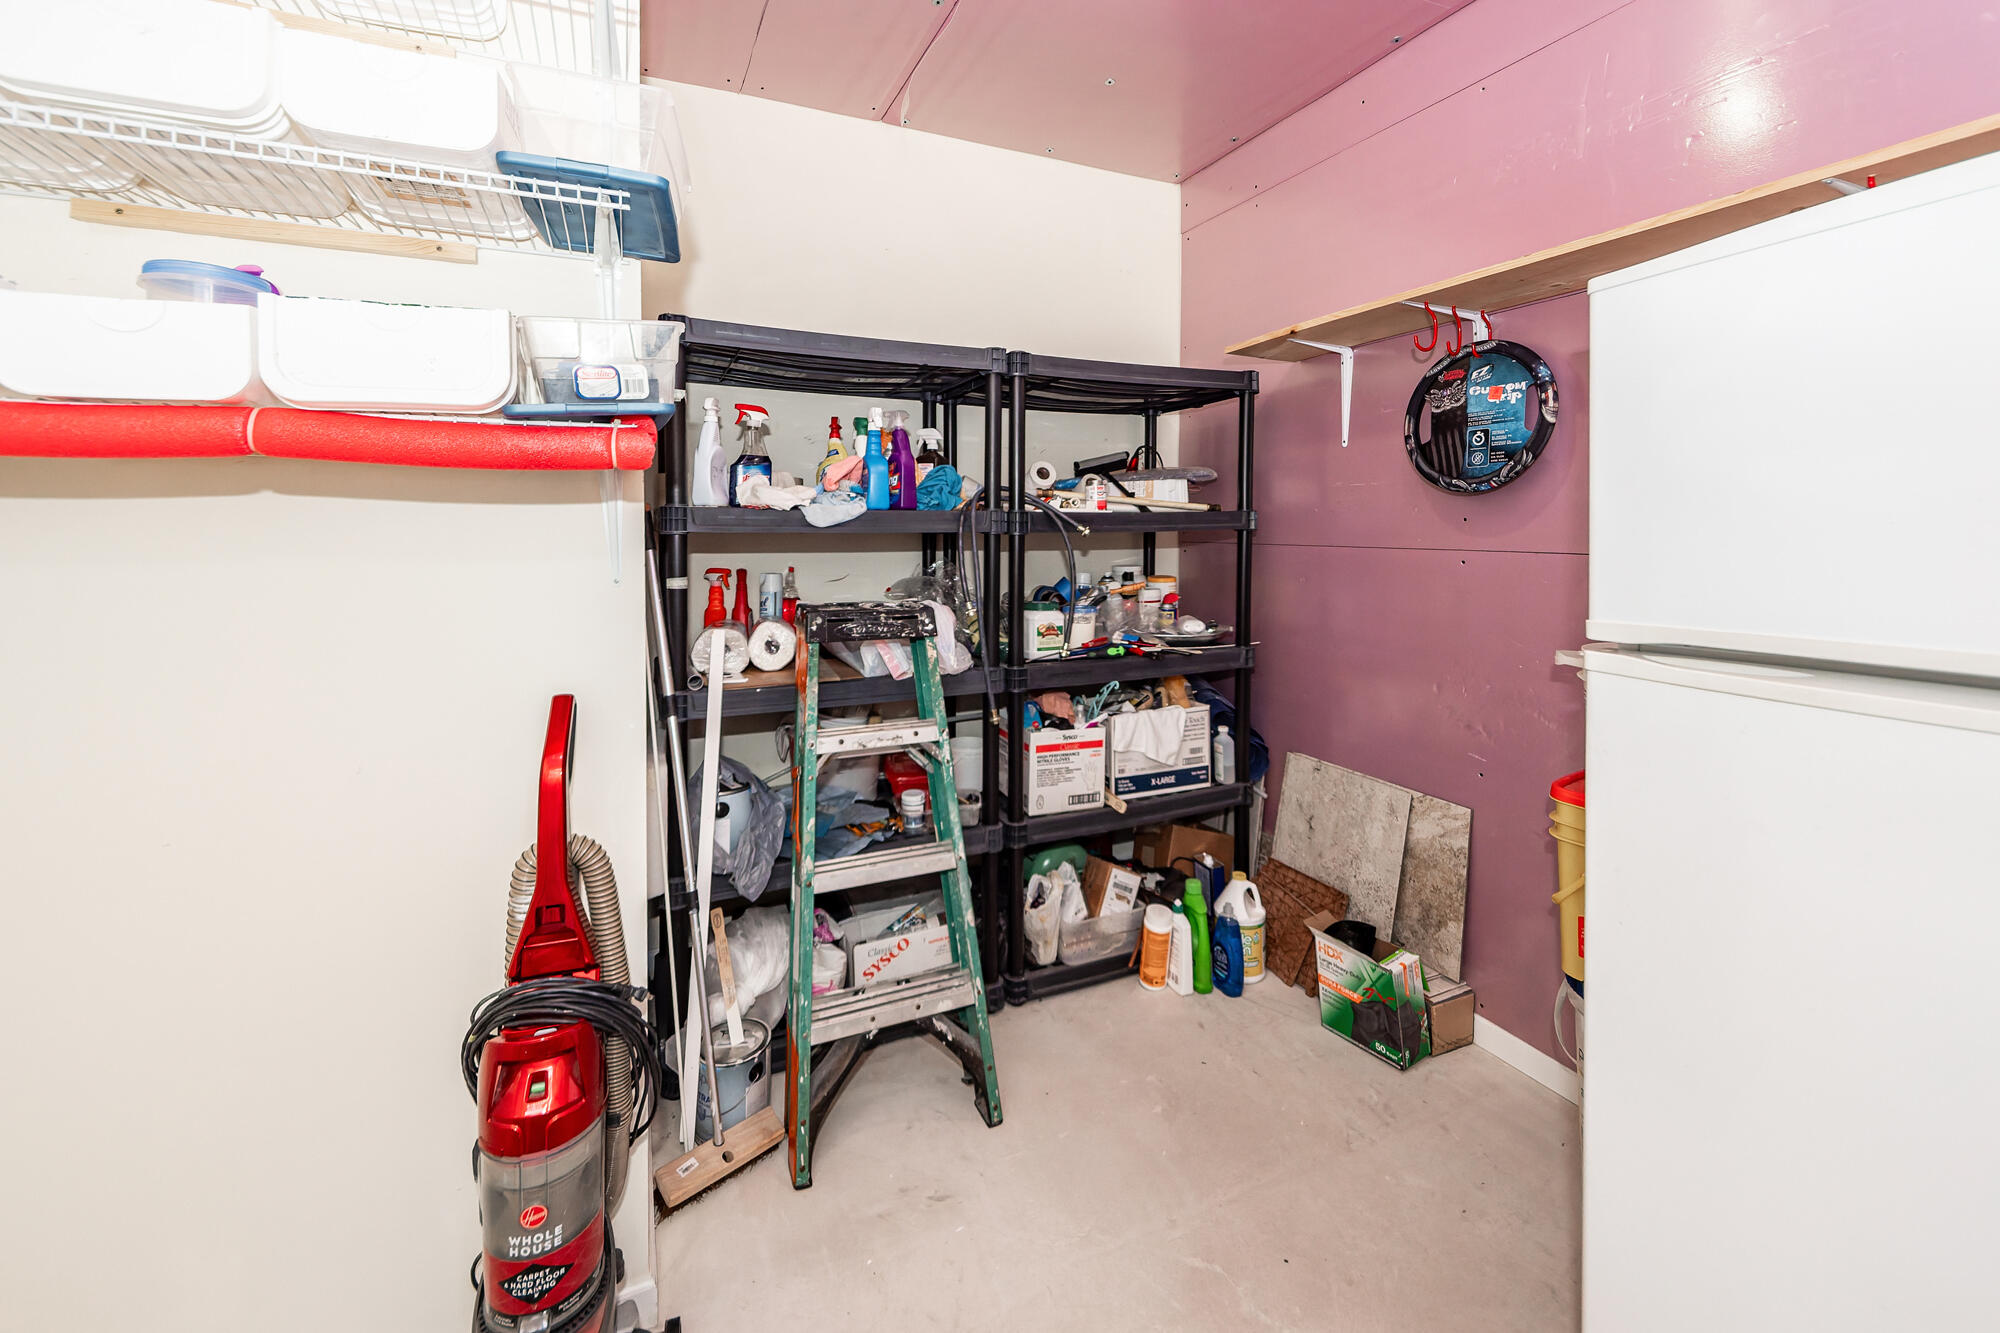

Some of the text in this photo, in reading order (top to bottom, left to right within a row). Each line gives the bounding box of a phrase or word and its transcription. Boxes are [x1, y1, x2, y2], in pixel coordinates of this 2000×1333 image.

[1151, 774, 1176, 786] X-LARGE
[862, 937, 910, 982] SYSCO
[1317, 940, 1344, 964] HDX
[508, 1224, 563, 1247] WHOLE
[508, 1234, 563, 1258] HOUSE
[510, 1280, 534, 1290] HARD
[535, 1267, 566, 1287] FLOOR
[516, 1267, 551, 1282] CARPET
